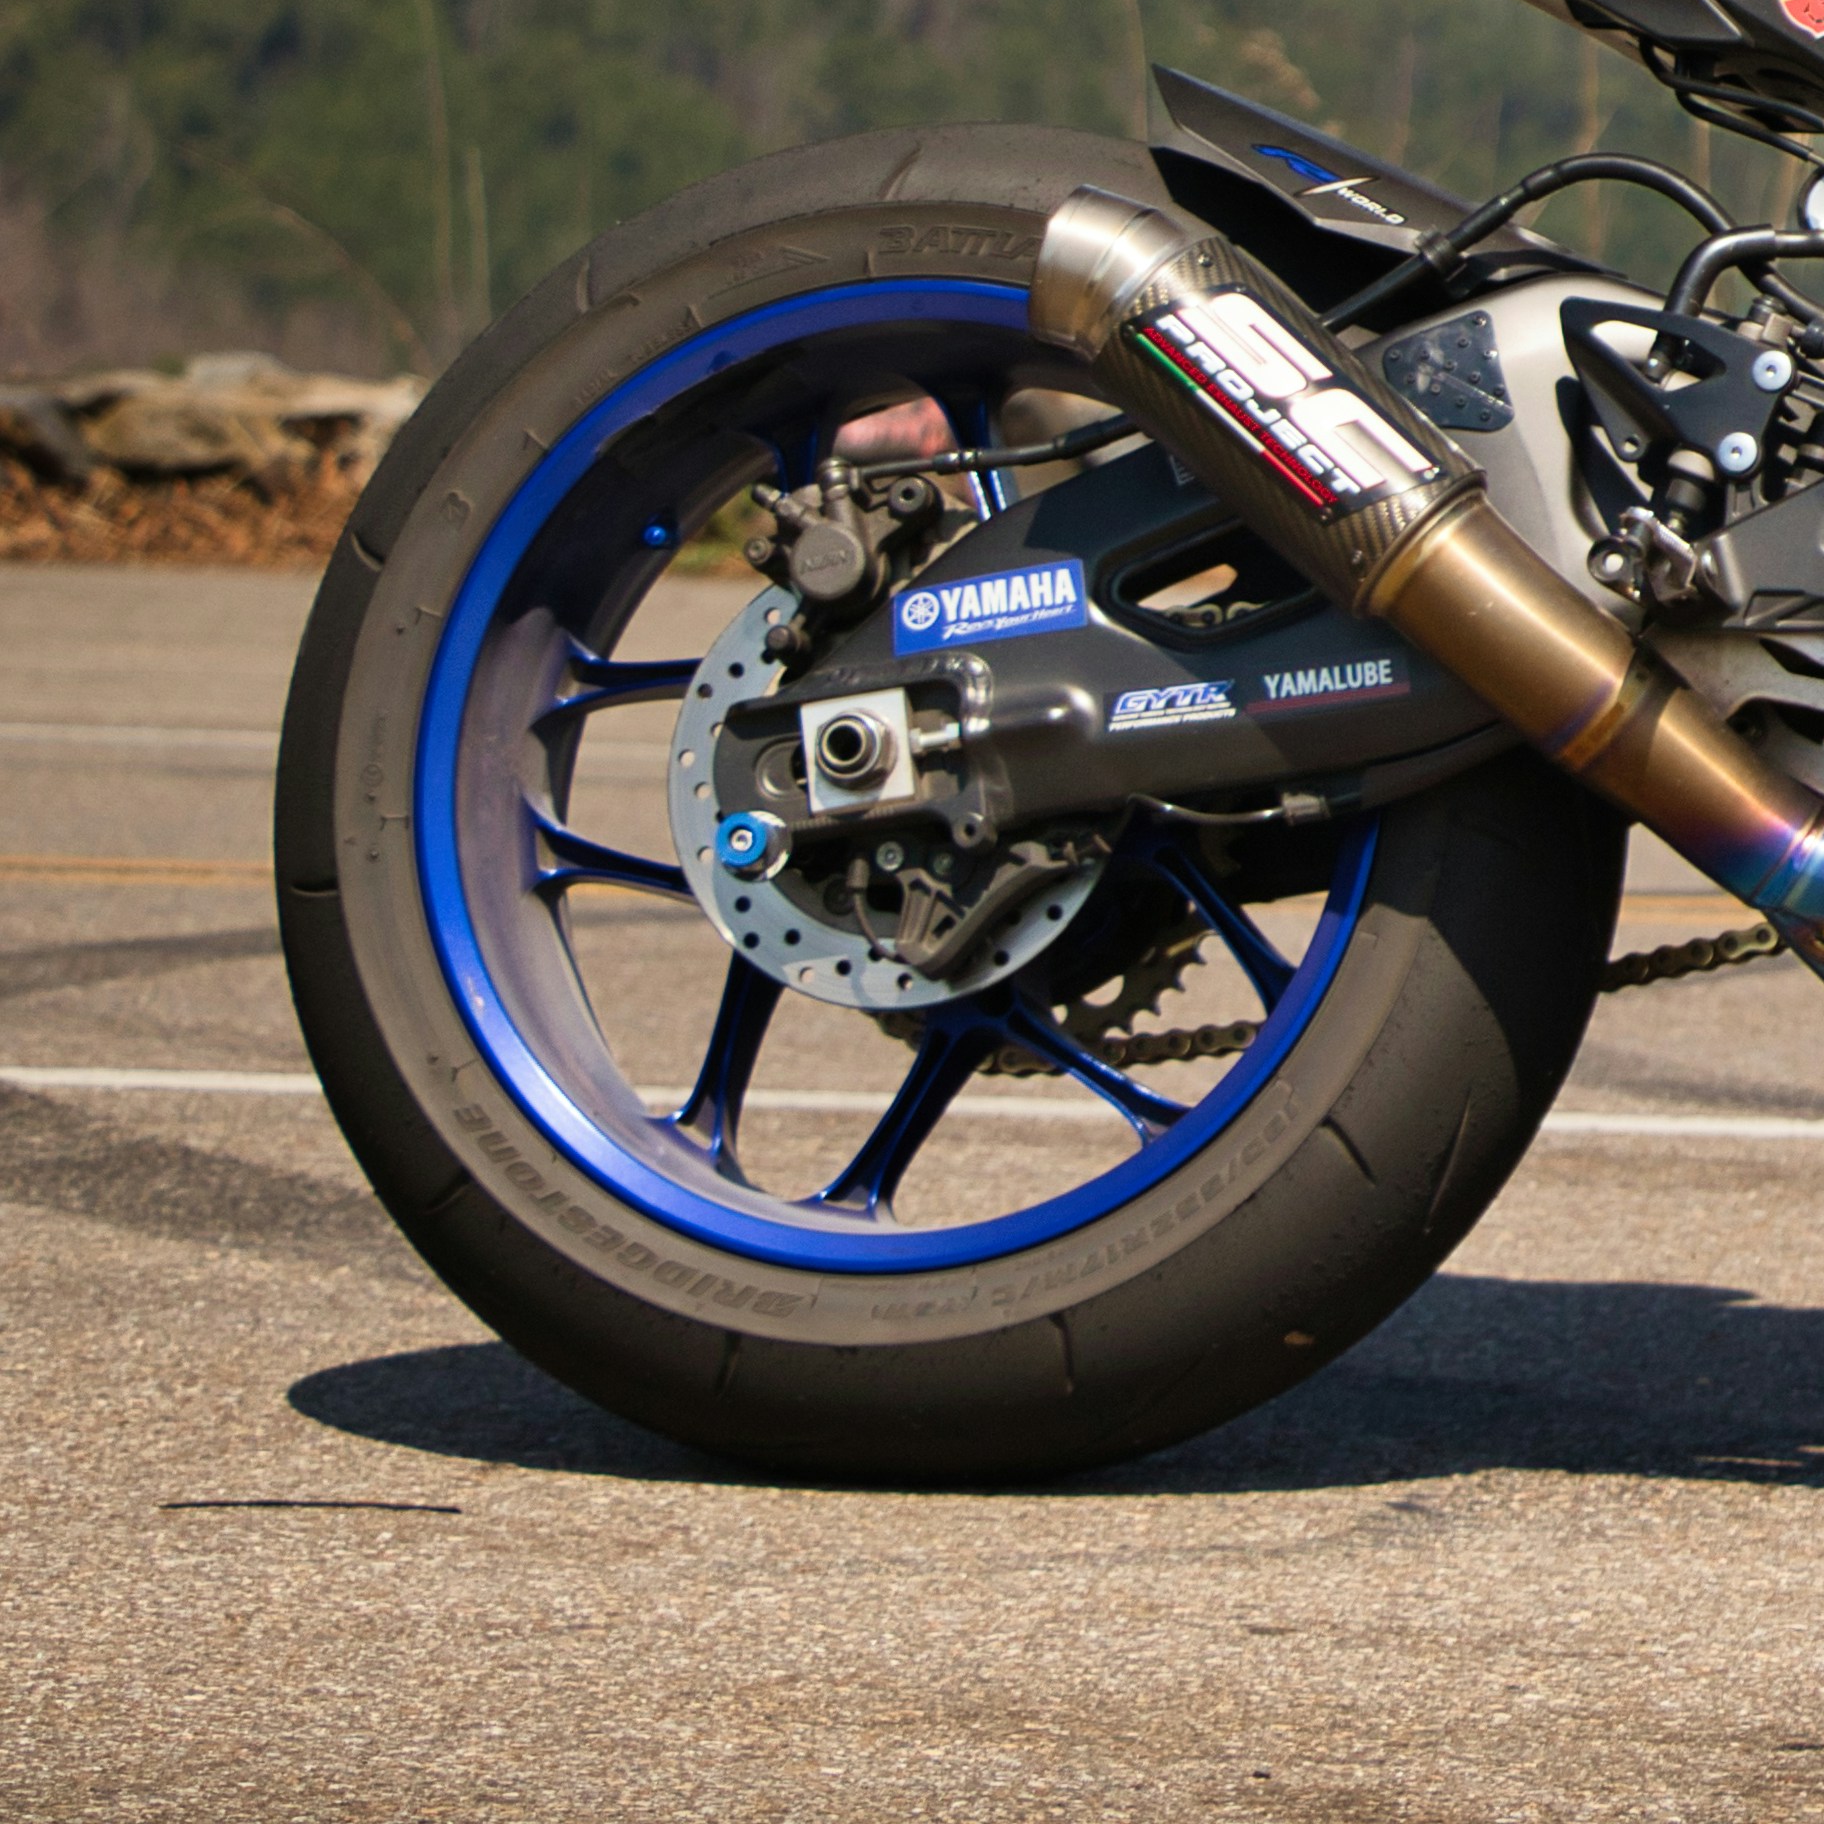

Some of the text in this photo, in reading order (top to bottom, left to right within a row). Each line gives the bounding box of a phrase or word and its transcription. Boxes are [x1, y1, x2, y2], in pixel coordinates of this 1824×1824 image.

[1337, 186, 1405, 225] WORLD
[1142, 326, 1339, 504] ADVANCED EXHAUST TECHNOLOGY
[1155, 314, 1361, 494] PROJECT
[939, 568, 1078, 623] YAMAHA
[1114, 679, 1236, 715] GYTR
[1264, 659, 1393, 700] YAMALUBE
[449, 1094, 806, 1321] BRIDGESTONE
